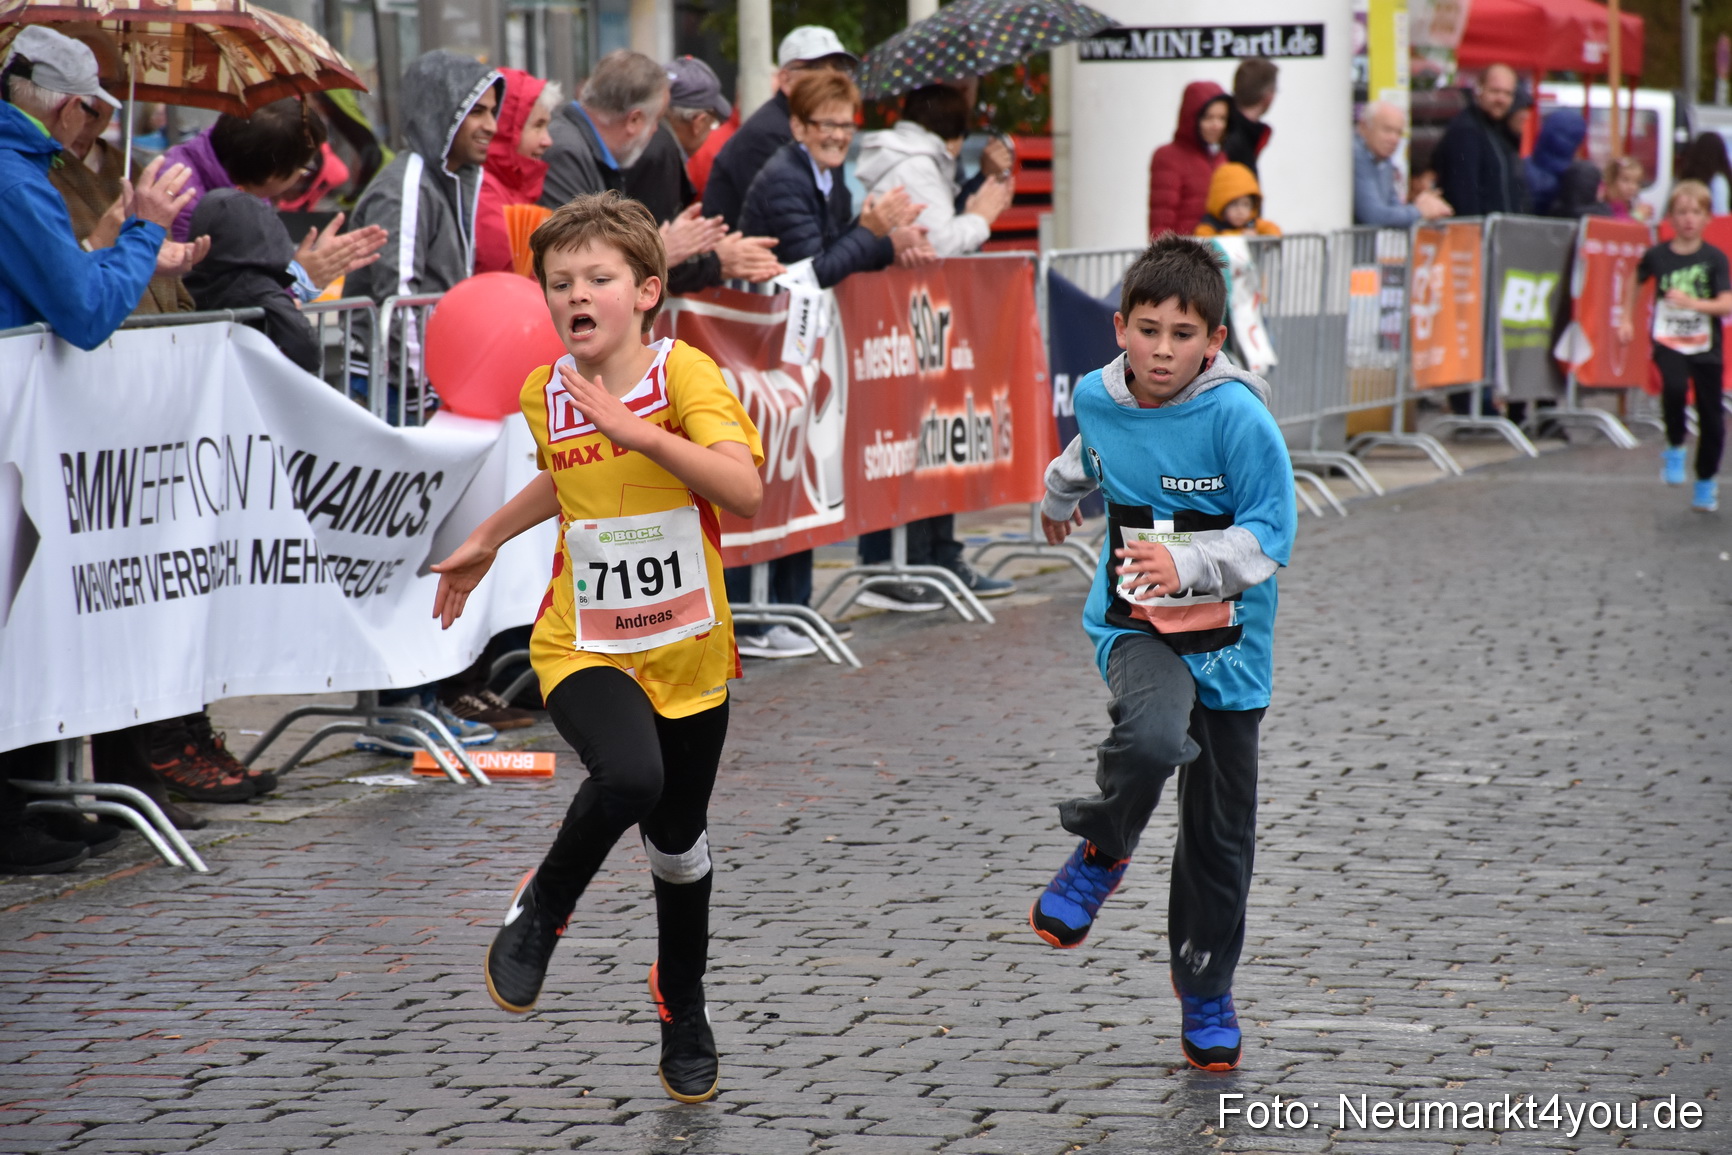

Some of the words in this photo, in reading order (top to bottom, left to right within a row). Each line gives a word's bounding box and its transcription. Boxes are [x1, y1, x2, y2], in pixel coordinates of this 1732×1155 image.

[1080, 26, 1317, 58] www.MINI-Partl.de
[552, 443, 604, 472] MAX
[60, 447, 138, 534] BMW
[1160, 474, 1227, 493] BOCK
[613, 526, 663, 542] BOCK
[1147, 533, 1193, 544] BOCK
[72, 556, 146, 615] WENIGER
[589, 550, 682, 601] 7191
[615, 608, 673, 630] Andreas
[449, 753, 534, 769] BRANDIG
